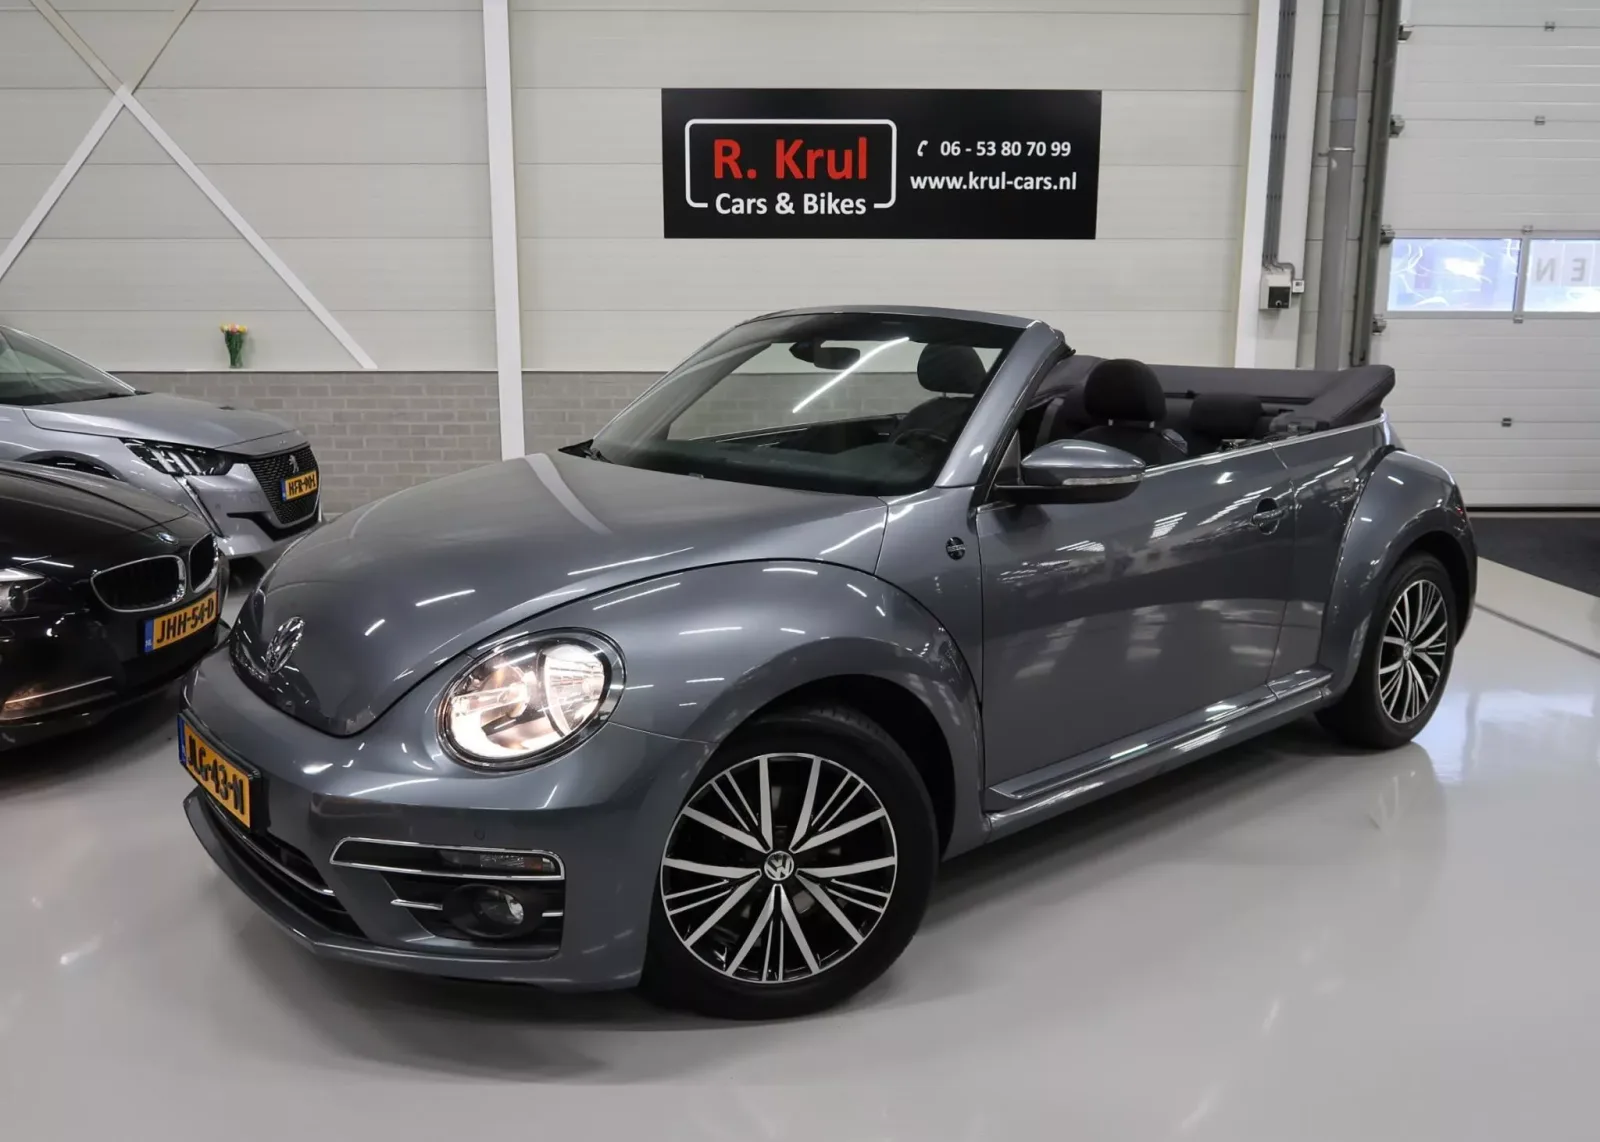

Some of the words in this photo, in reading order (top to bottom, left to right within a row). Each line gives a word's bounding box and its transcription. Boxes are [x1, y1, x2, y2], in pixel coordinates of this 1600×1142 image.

[713, 138, 757, 180] R.
[775, 136, 868, 180] Krul
[940, 140, 962, 157] 06
[976, 140, 997, 157] 53
[1000, 140, 1022, 157] 80
[1026, 141, 1047, 157] 70
[1050, 141, 1072, 157] 99
[909, 170, 1077, 190] www.krul-cars.nl
[715, 192, 768, 215] Cars
[774, 191, 796, 215] &
[803, 191, 867, 215] Bikes
[156, 597, 214, 643] JHH-54-D
